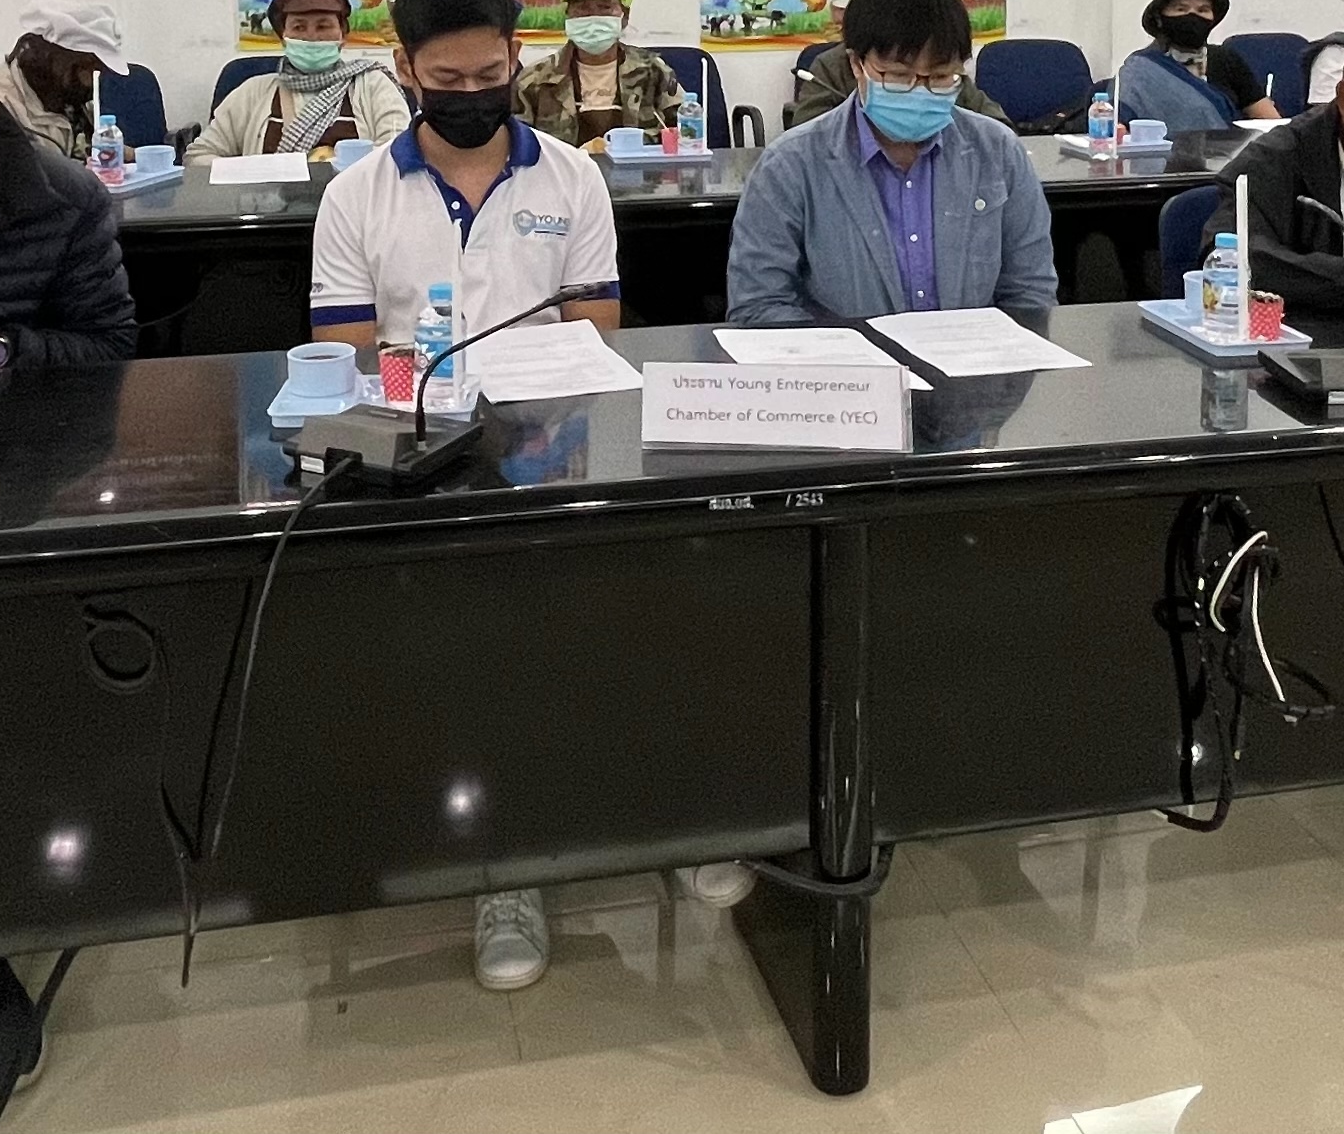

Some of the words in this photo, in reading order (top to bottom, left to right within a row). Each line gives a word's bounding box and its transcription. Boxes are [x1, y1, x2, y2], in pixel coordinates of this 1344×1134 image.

[672, 374, 723, 390] ประธาน
[728, 376, 771, 393] Young
[776, 377, 871, 394] Entrepreneur
[666, 407, 732, 422] Chamber
[736, 408, 753, 422] of
[757, 409, 836, 423] Commerce
[840, 410, 878, 425] (YEC)
